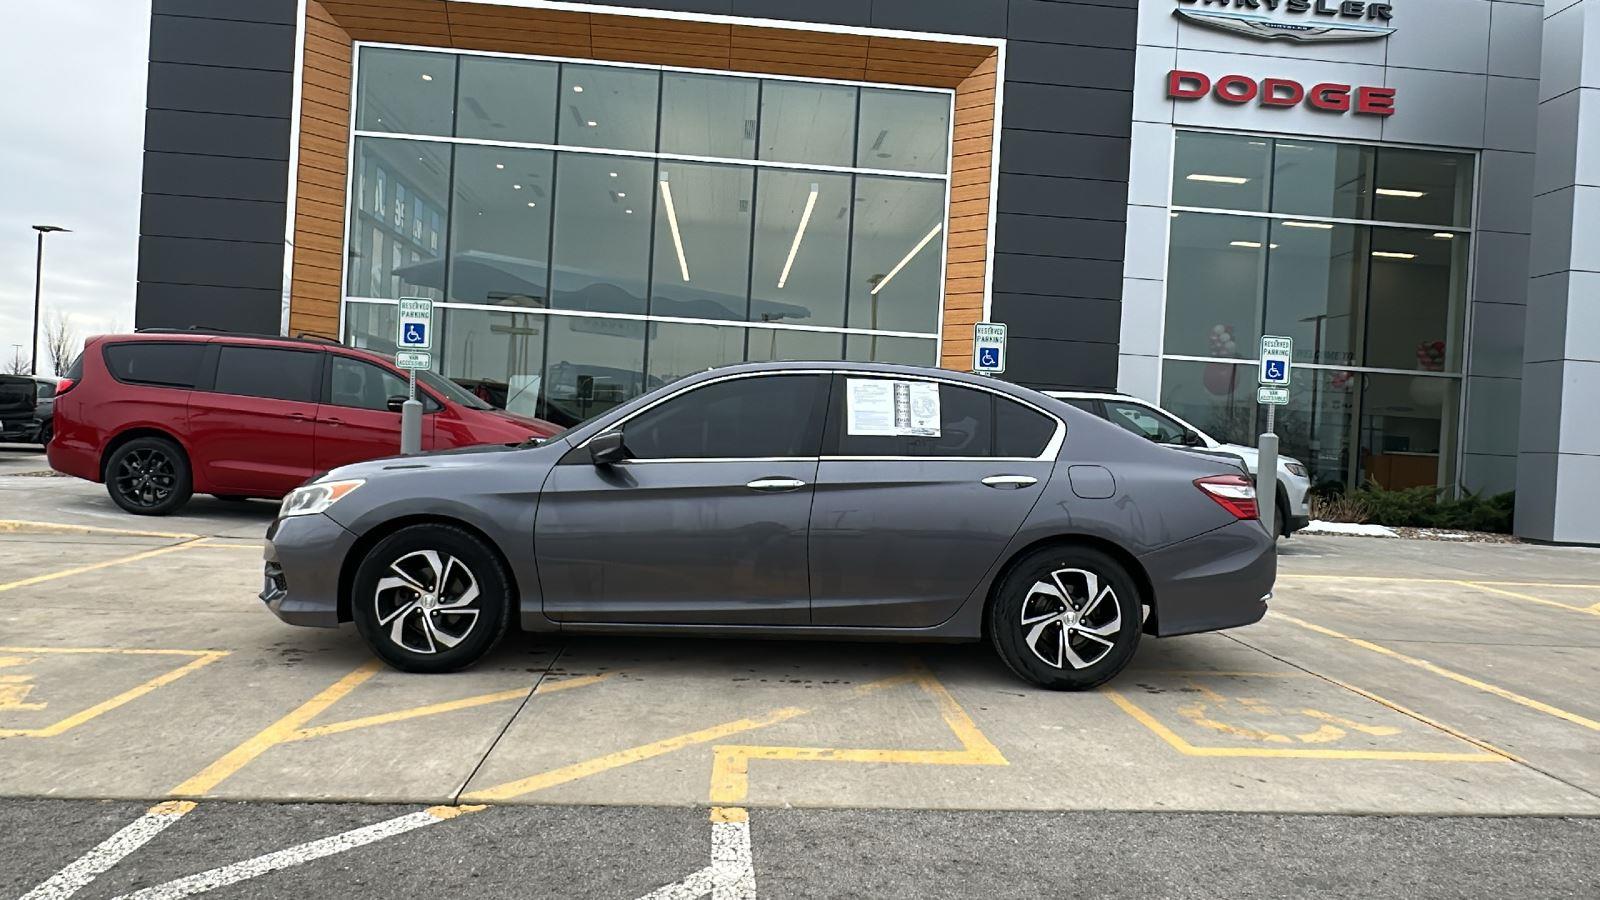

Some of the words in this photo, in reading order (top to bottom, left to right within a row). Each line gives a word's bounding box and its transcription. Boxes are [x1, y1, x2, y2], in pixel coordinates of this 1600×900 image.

[1167, 70, 1396, 116] DODGE
[402, 301, 429, 310] RESERVED
[977, 327, 1003, 335] RESERVED
[977, 335, 1003, 343] PARKING
[1264, 340, 1289, 348] RESERVED
